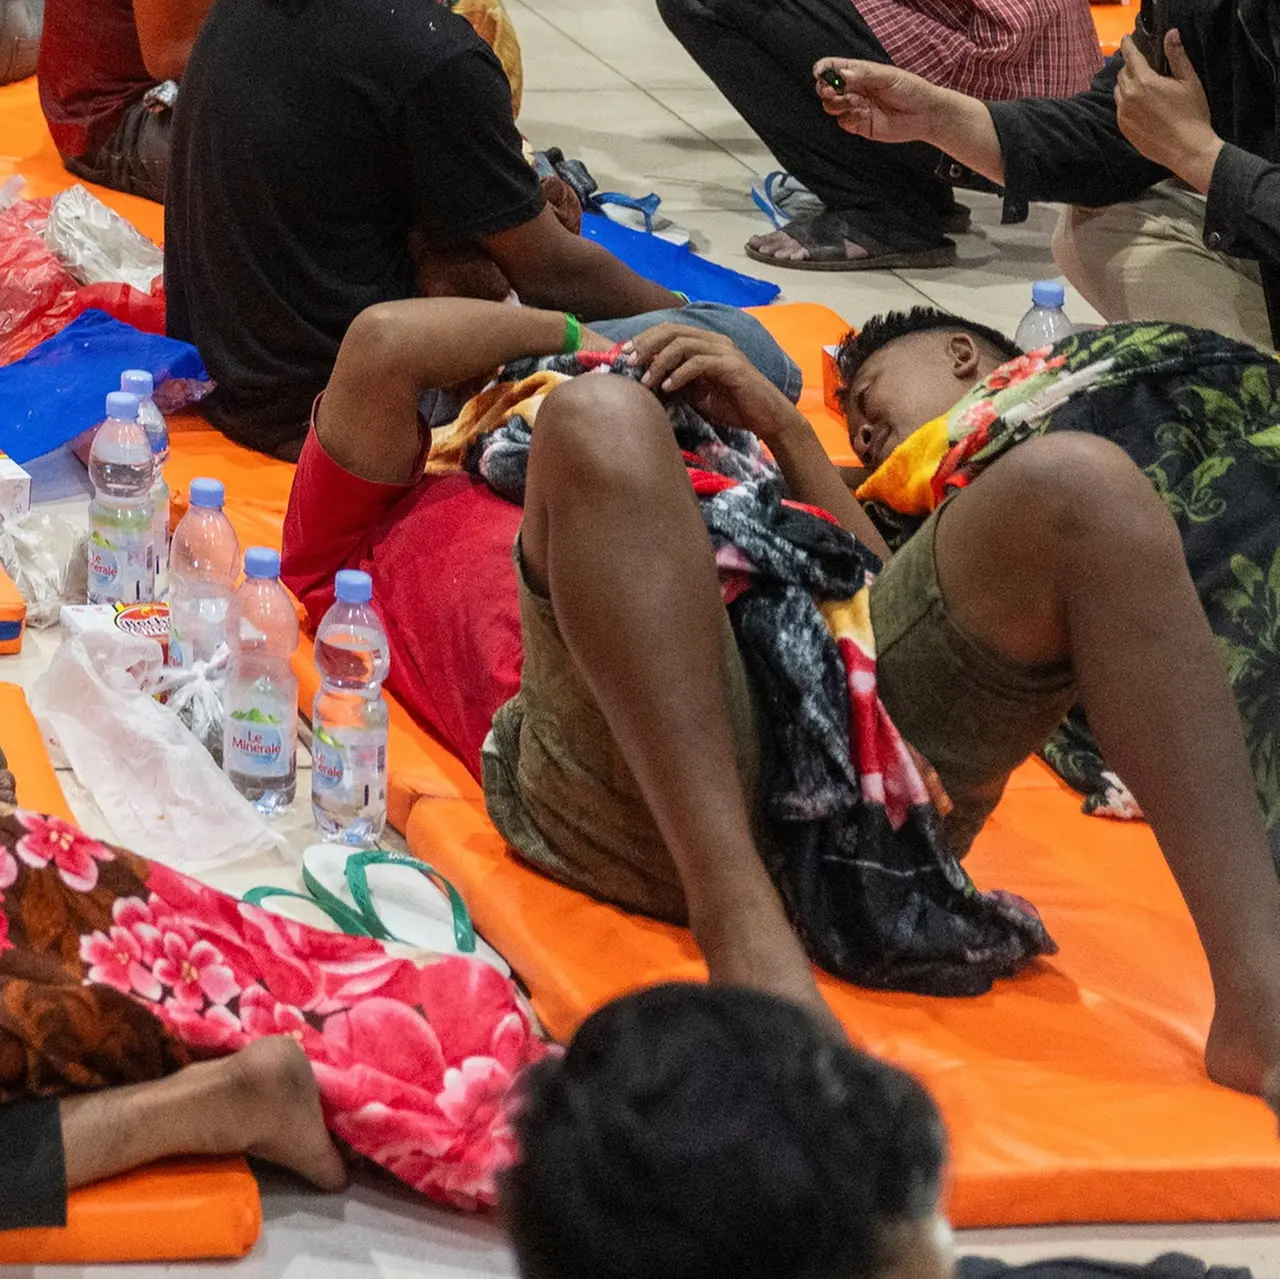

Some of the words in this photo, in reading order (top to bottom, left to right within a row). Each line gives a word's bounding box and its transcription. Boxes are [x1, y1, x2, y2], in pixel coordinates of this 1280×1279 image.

[248, 730, 263, 743] Le
[232, 736, 281, 755] Minerale
[315, 748, 326, 761] Le
[312, 760, 344, 778] erale
